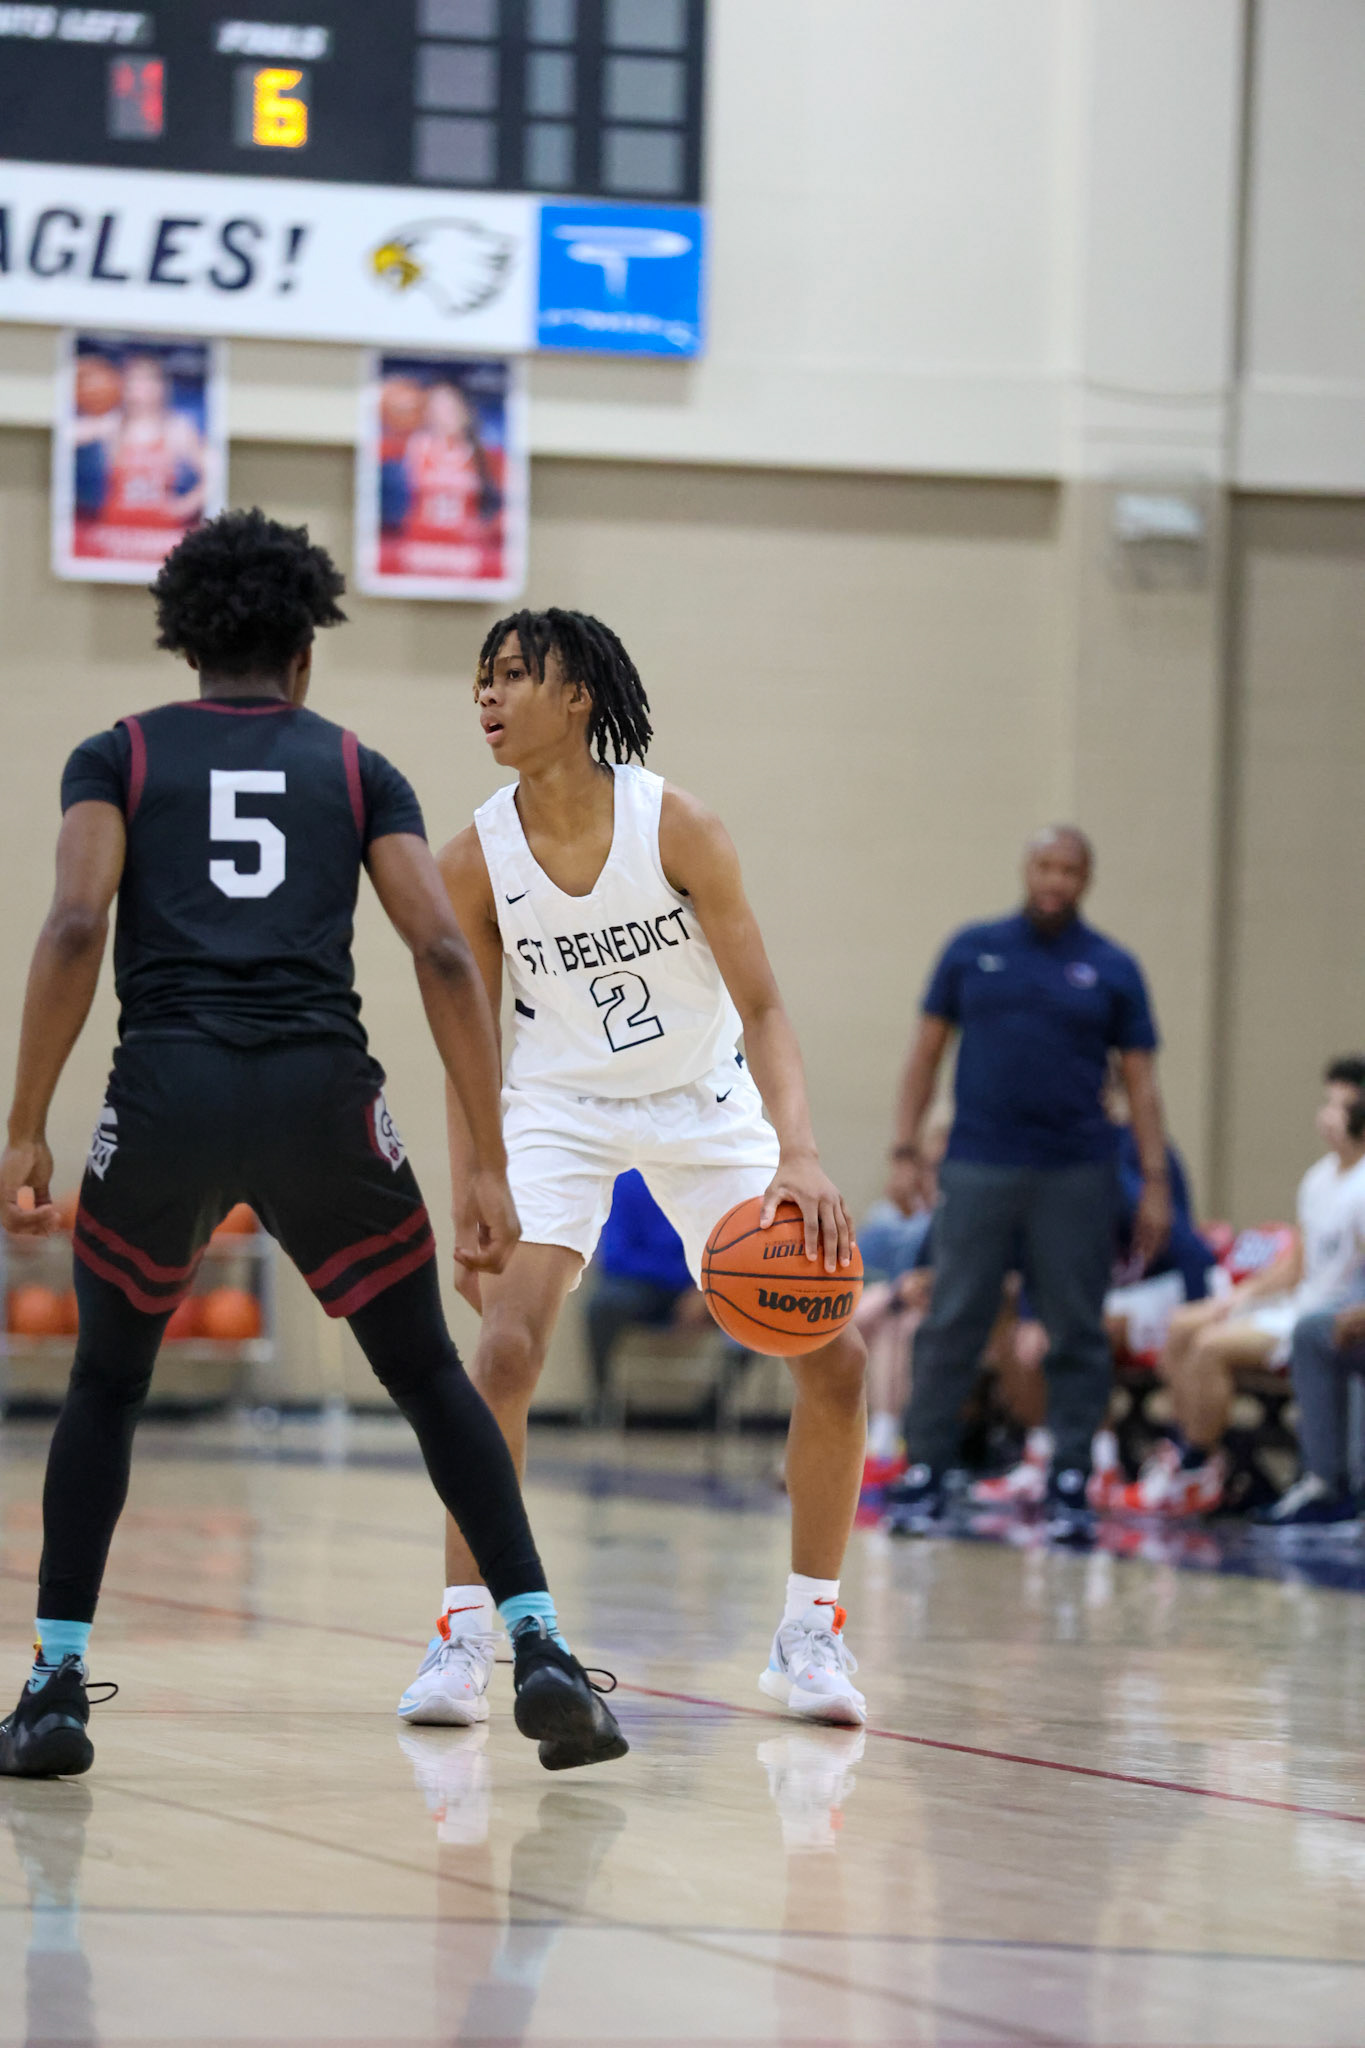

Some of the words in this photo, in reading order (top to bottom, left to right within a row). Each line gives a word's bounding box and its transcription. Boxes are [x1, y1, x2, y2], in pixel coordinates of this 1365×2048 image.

[252, 67, 308, 148] 6
[209, 769, 286, 899] 5
[516, 938, 558, 976] ST.
[554, 907, 691, 973] BENEDICT
[590, 970, 664, 1053] 2
[757, 1288, 854, 1323] Wilson
